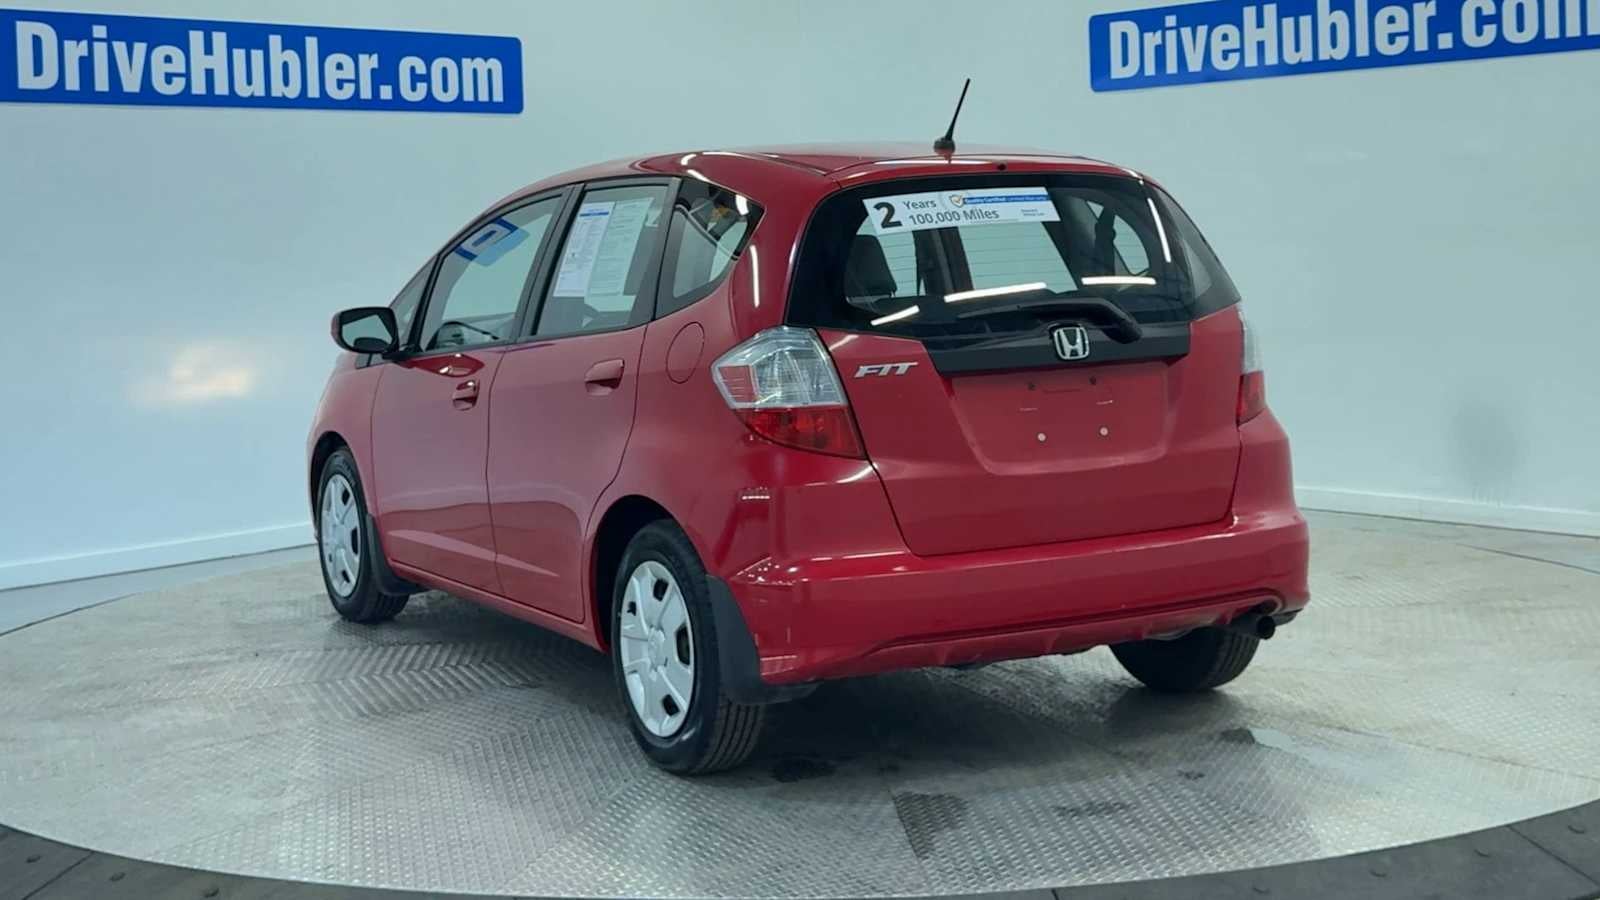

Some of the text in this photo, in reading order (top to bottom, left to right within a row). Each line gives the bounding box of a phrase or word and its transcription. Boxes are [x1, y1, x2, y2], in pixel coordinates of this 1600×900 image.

[1108, 0, 1600, 80] DriveHubler.com
[15, 20, 504, 103] DriveHubler.com
[873, 199, 937, 229] 2 Years
[909, 207, 1000, 226] 100,000 Miles
[854, 362, 919, 378] FIT
